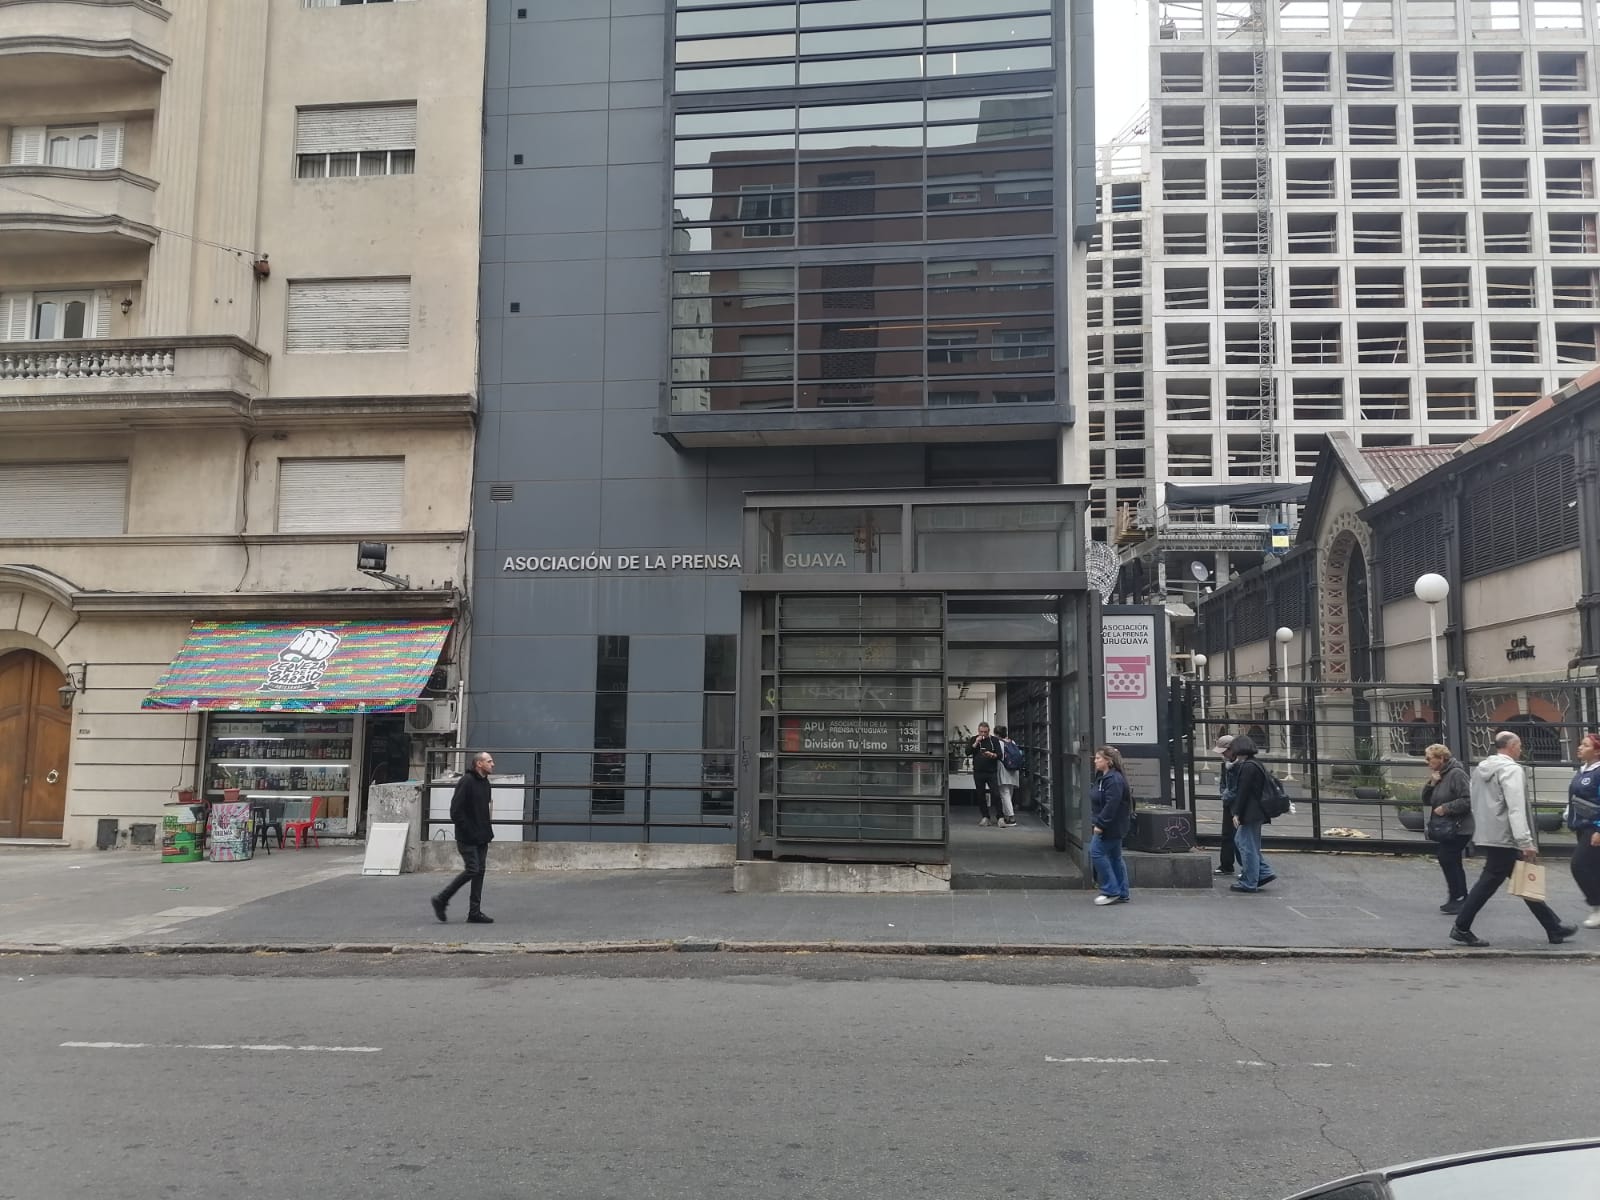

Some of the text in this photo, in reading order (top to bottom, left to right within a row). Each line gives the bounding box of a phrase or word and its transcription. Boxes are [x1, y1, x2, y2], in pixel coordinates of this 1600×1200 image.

[503, 552, 612, 571] ASOCIACIÓN
[617, 555, 640, 570] DE
[644, 555, 667, 569] LA
[671, 554, 742, 569] PRENSA
[1102, 637, 1149, 645] URUGUAYA
[268, 659, 327, 674] CERVEZA
[804, 721, 825, 732] APU
[804, 738, 845, 750] División
